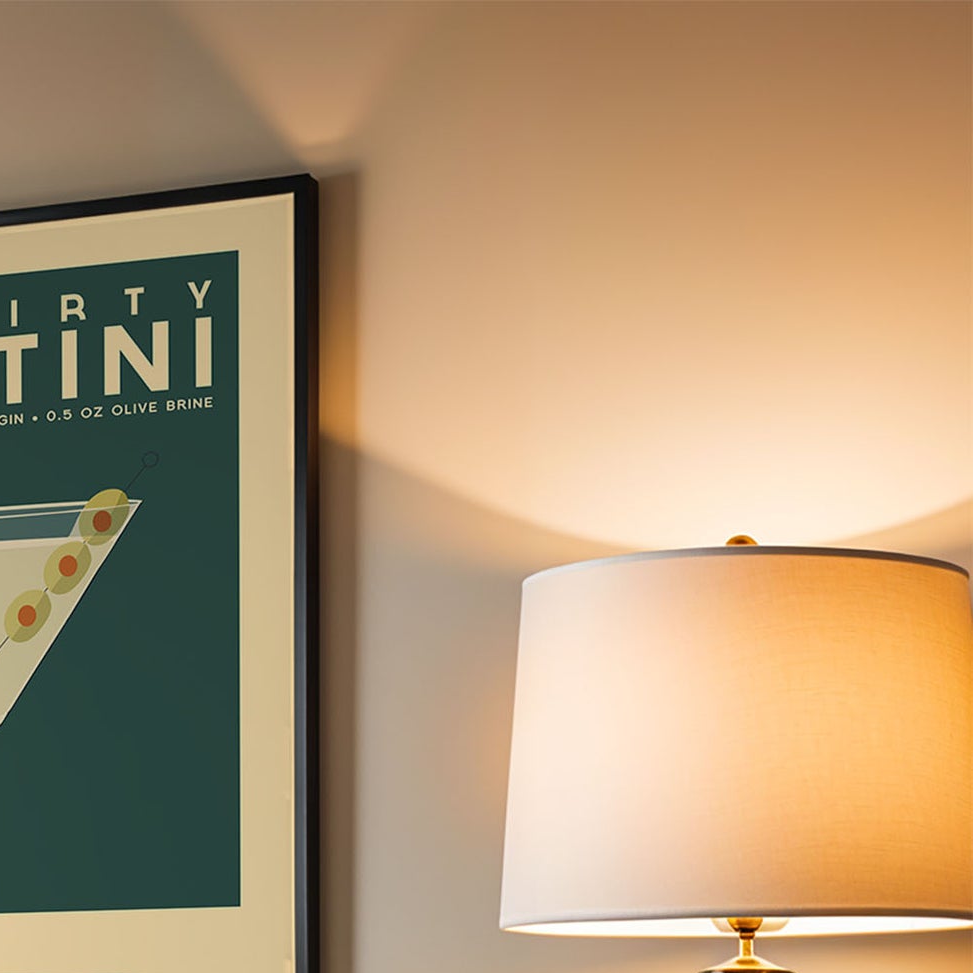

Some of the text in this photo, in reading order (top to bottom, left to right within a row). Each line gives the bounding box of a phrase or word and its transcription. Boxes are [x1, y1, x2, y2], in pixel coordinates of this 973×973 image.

[46, 409, 73, 422] 0.5
[80, 406, 103, 419] OZ
[111, 401, 158, 417] OLIVE
[166, 396, 213, 412] BRINE
